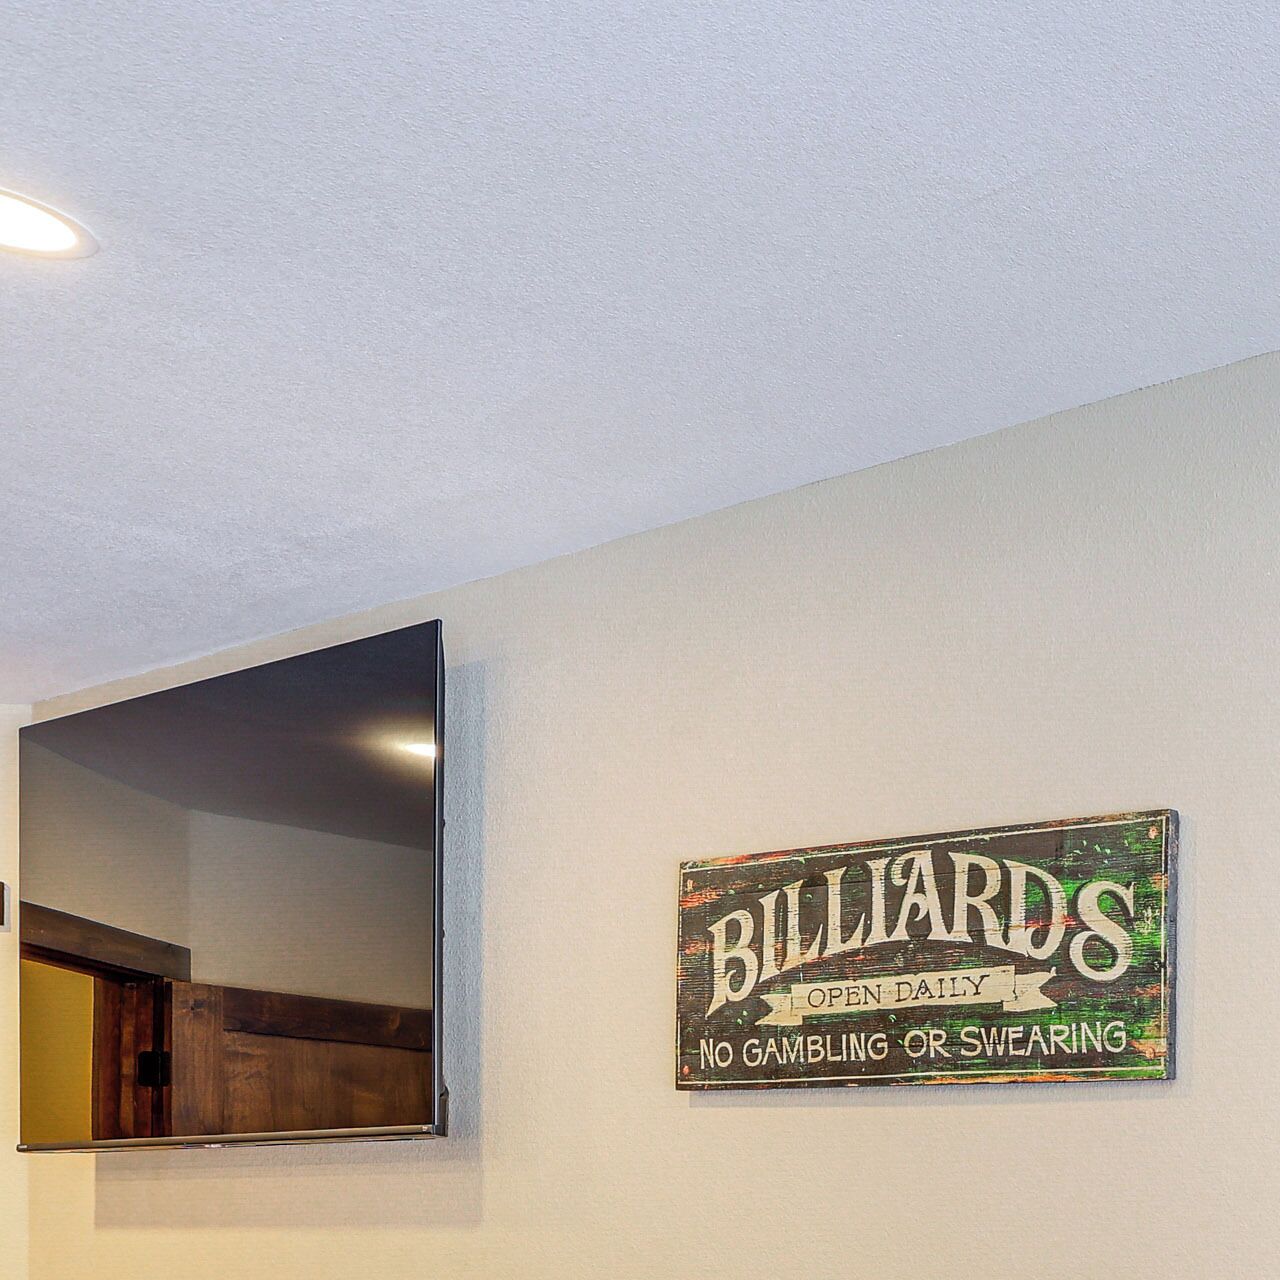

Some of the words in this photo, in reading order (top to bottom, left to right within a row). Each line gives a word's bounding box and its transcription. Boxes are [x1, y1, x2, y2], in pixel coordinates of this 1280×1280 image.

[706, 850, 1136, 1020] BILLIARDS
[808, 985, 882, 1009] OPEN
[895, 975, 990, 1003] DAILY
[700, 1038, 733, 1069] NO
[743, 1033, 888, 1067] GAMBLING
[904, 1028, 952, 1060] OR
[960, 1021, 1128, 1058] SWEARING
